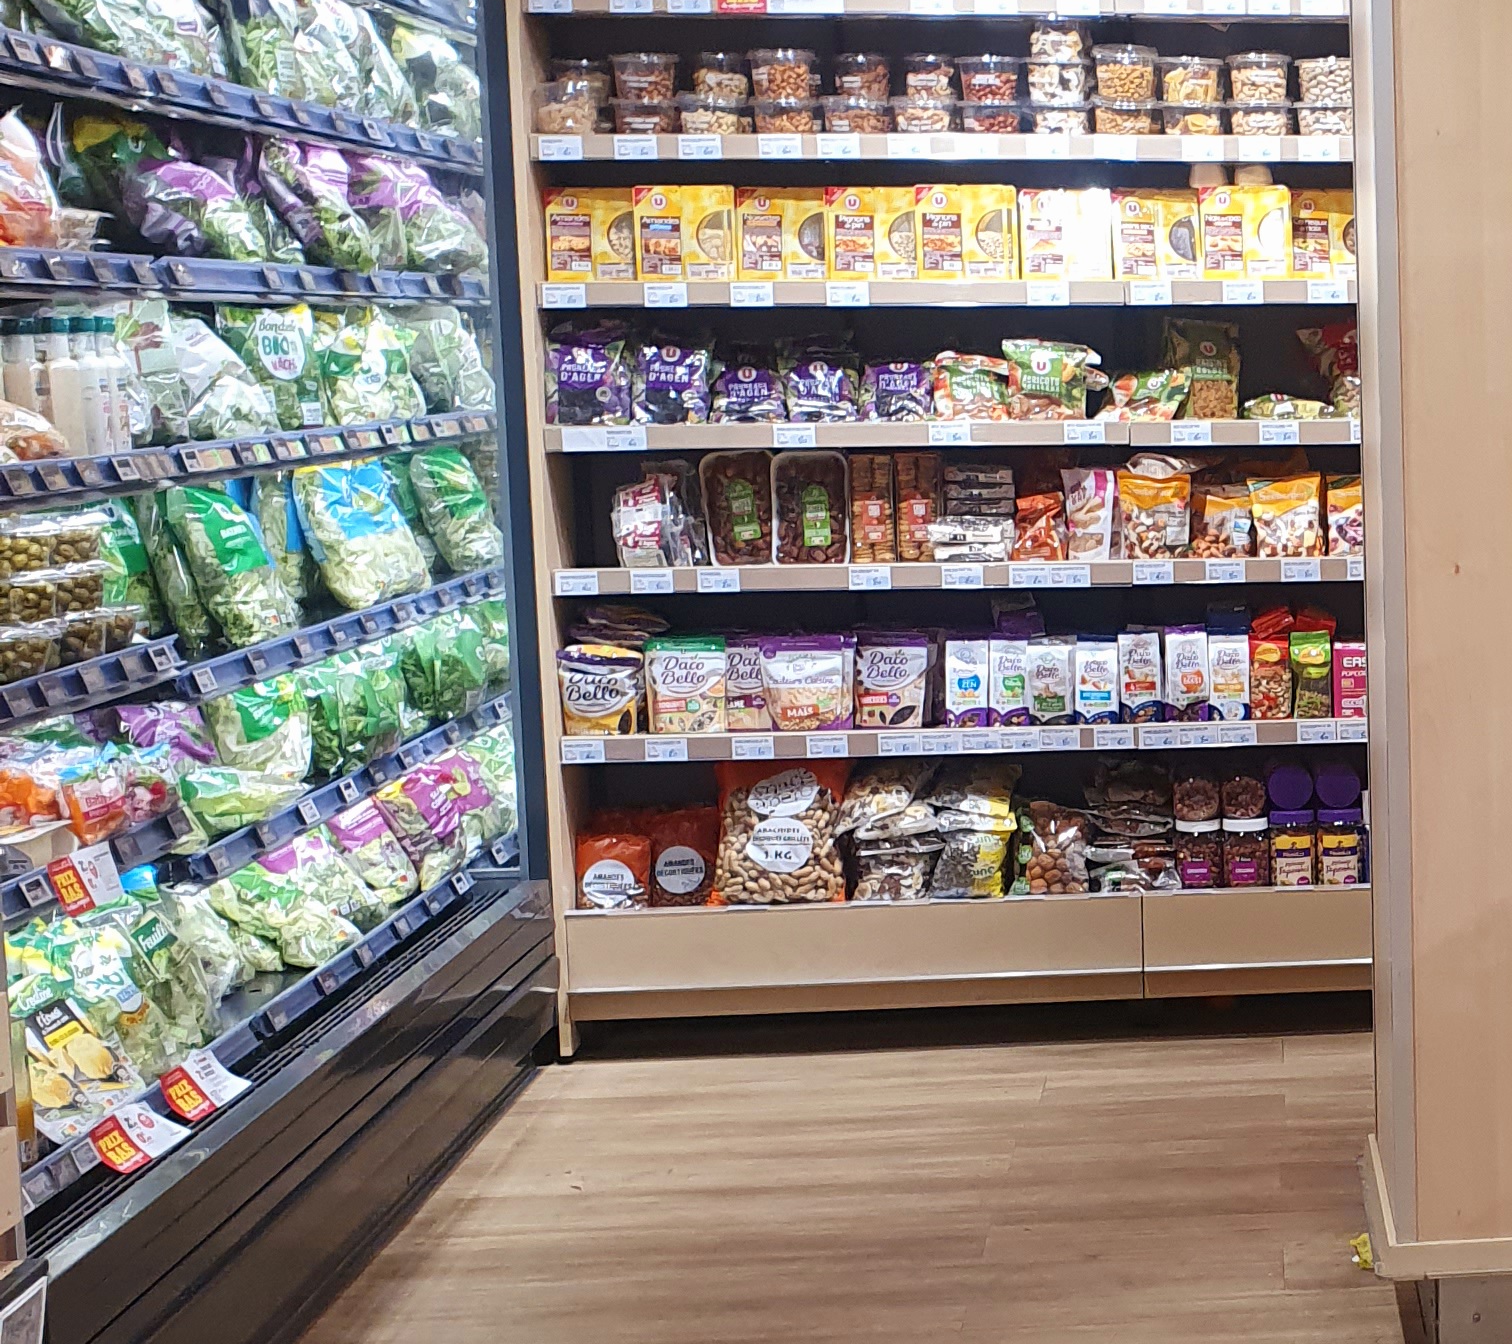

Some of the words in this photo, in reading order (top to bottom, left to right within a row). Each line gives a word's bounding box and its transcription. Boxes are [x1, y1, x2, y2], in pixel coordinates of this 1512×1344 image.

[662, 655, 704, 671] Daco
[727, 652, 760, 667] Dac
[869, 650, 909, 666] Daco
[661, 670, 706, 685] Bello
[726, 666, 762, 682] Bell
[866, 664, 909, 680] Bello
[566, 684, 620, 702] Bello
[168, 1078, 194, 1099] PRIX
[175, 1090, 204, 1113] BAS
[98, 1129, 125, 1154] PRIX
[106, 1141, 137, 1166] BAS
